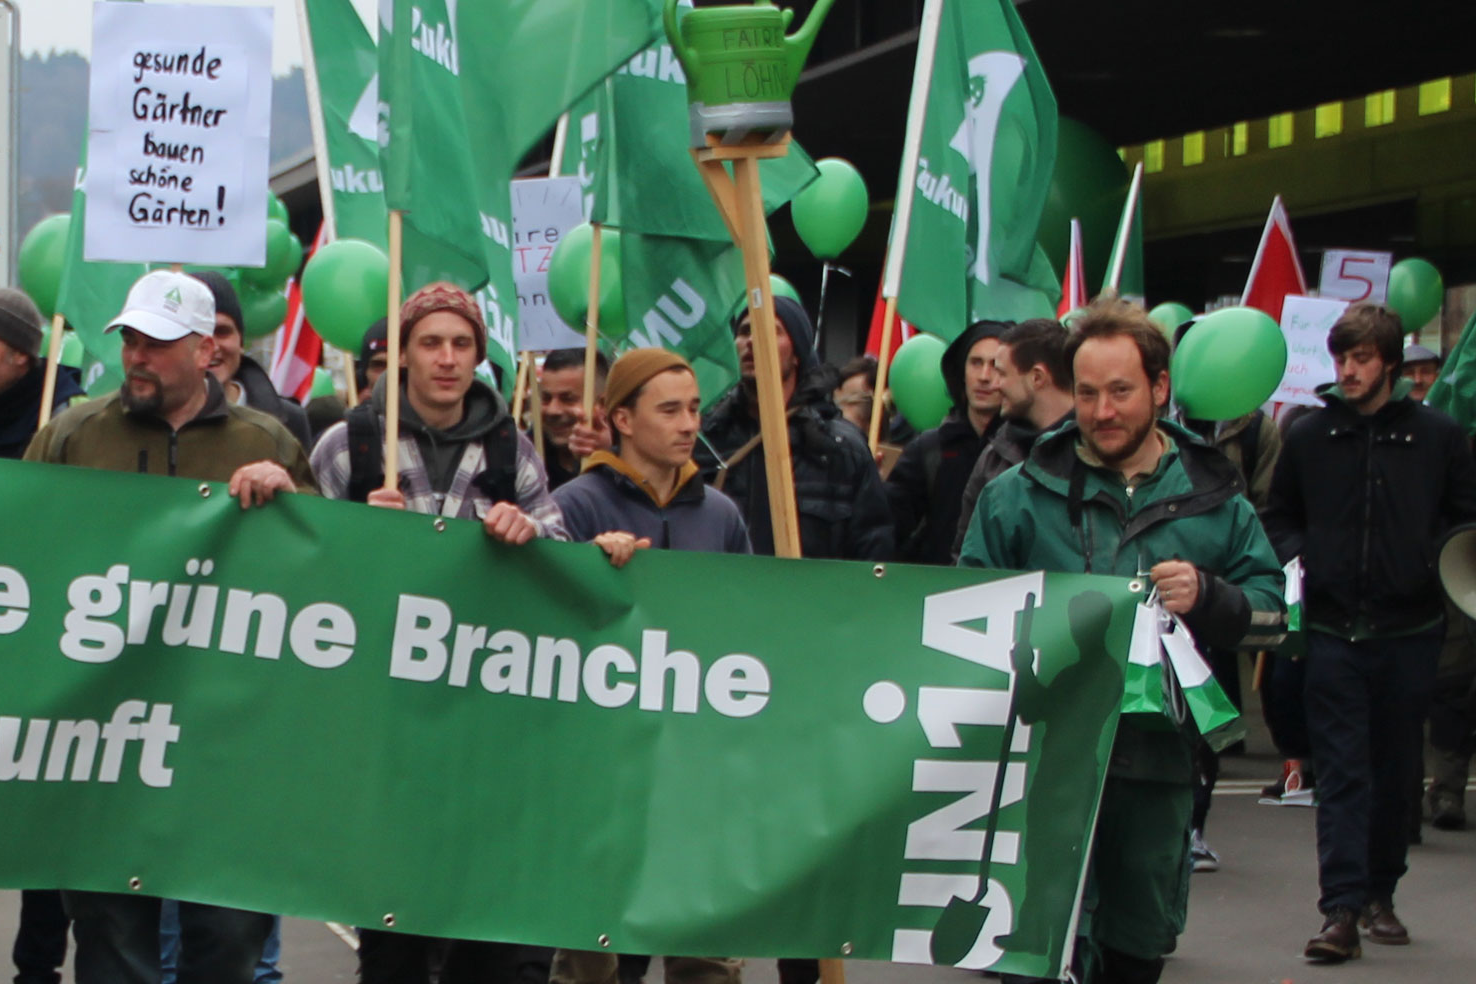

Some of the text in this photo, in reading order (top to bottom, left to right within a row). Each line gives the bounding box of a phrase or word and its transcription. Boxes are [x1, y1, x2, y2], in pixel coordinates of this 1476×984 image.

[133, 46, 222, 83] gesunde
[133, 87, 227, 128] Gärtner
[143, 132, 204, 165] bauen
[129, 166, 193, 192] schöne
[1339, 257, 1374, 304] 5
[59, 557, 357, 669] grüne
[389, 593, 771, 718] Branche
